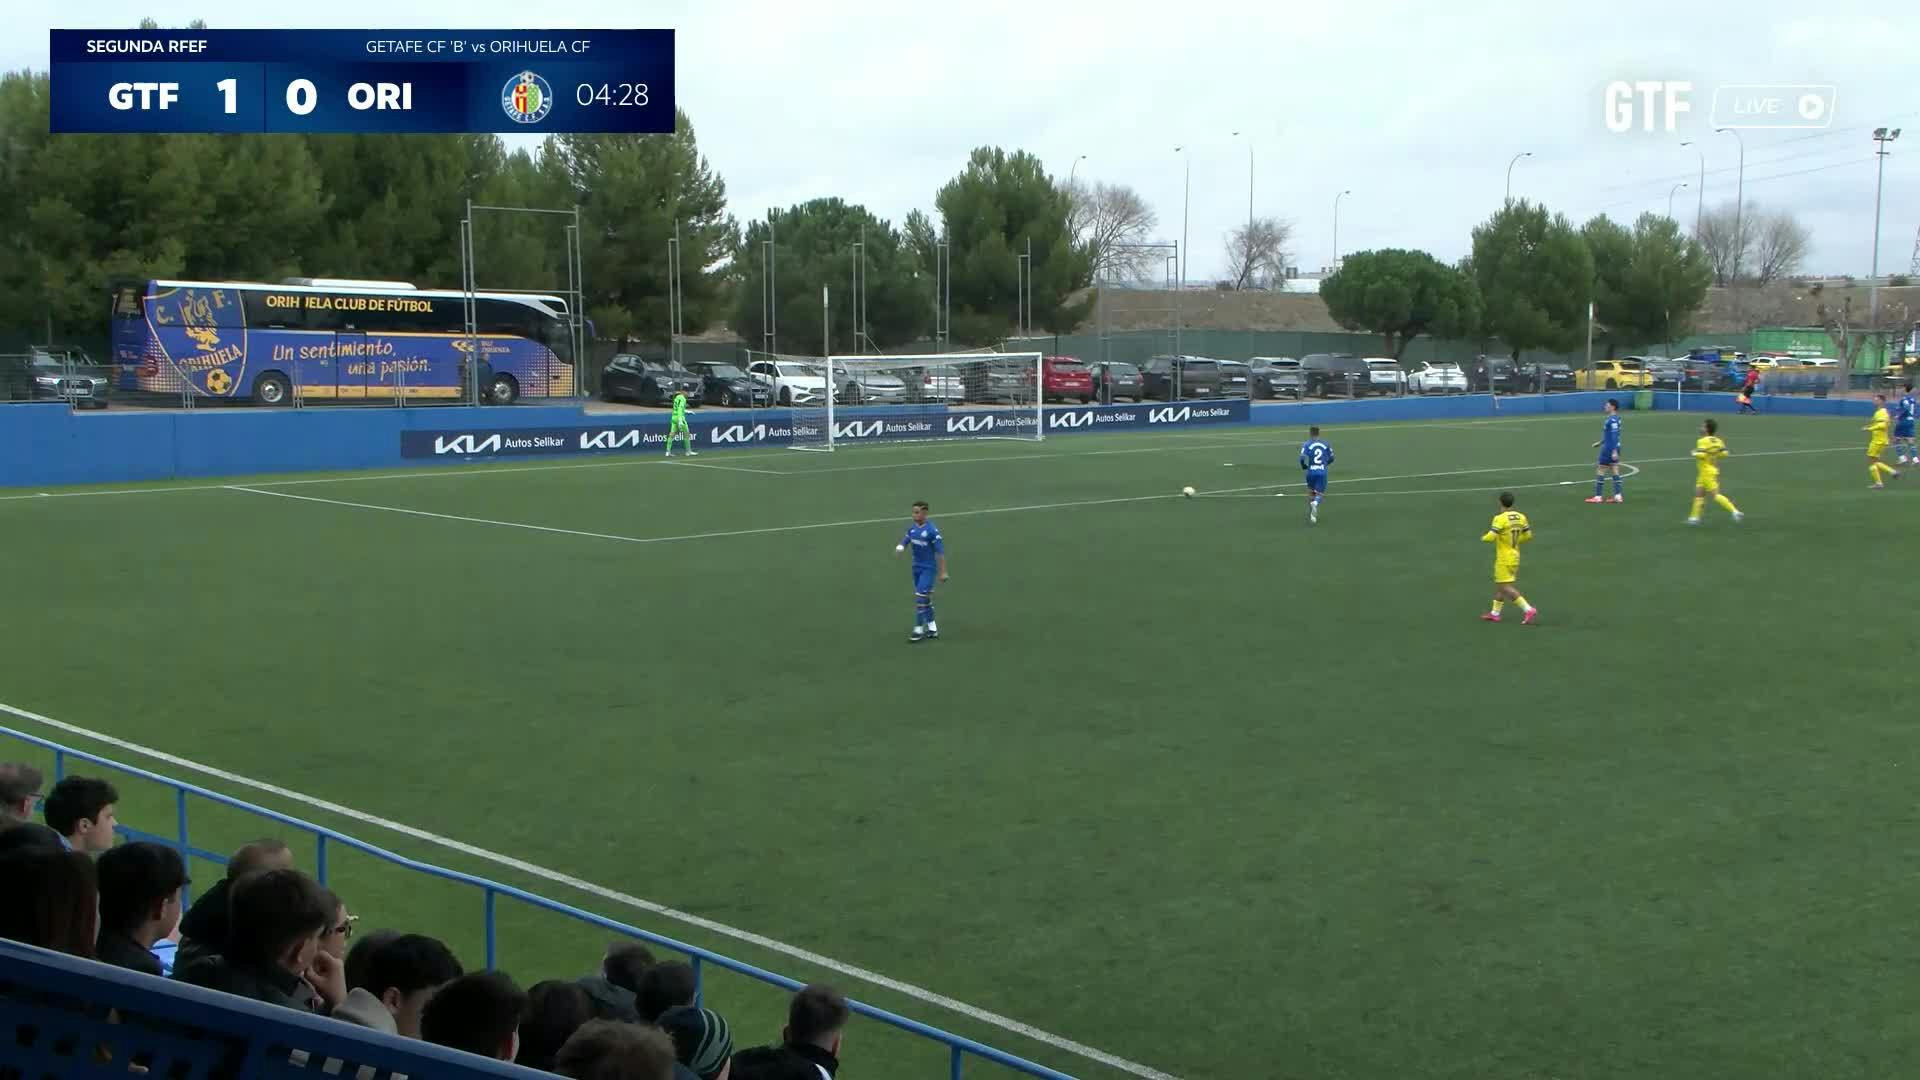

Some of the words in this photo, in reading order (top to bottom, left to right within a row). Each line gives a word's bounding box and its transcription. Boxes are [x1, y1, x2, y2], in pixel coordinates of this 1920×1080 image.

[334, 298, 366, 311] CLUB
[368, 299, 385, 311] DE
[387, 297, 433, 313] FÚTBOL
[178, 344, 243, 372] ORIHUELA
[273, 345, 294, 361] Un
[299, 339, 397, 359] sentimiento,
[347, 361, 376, 375] una
[380, 355, 432, 381] pasión.
[947, 415, 994, 432] KIA
[996, 418, 1015, 427] Autos
[1050, 411, 1093, 428] KIA
[1096, 414, 1114, 422] Autos
[1149, 406, 1190, 423] KIA
[1192, 409, 1209, 417] Autos
[711, 424, 766, 443] KIA
[768, 427, 791, 437] Autos
[833, 420, 883, 438] KIA
[886, 423, 906, 432] Autos
[435, 434, 501, 454] KIA
[505, 438, 532, 448] Autos
[534, 436, 565, 447] Selikar
[580, 430, 639, 449] KIA
[643, 433, 666, 443] Autos
[667, 431, 697, 442] eliar
[1313, 448, 1323, 464] 2
